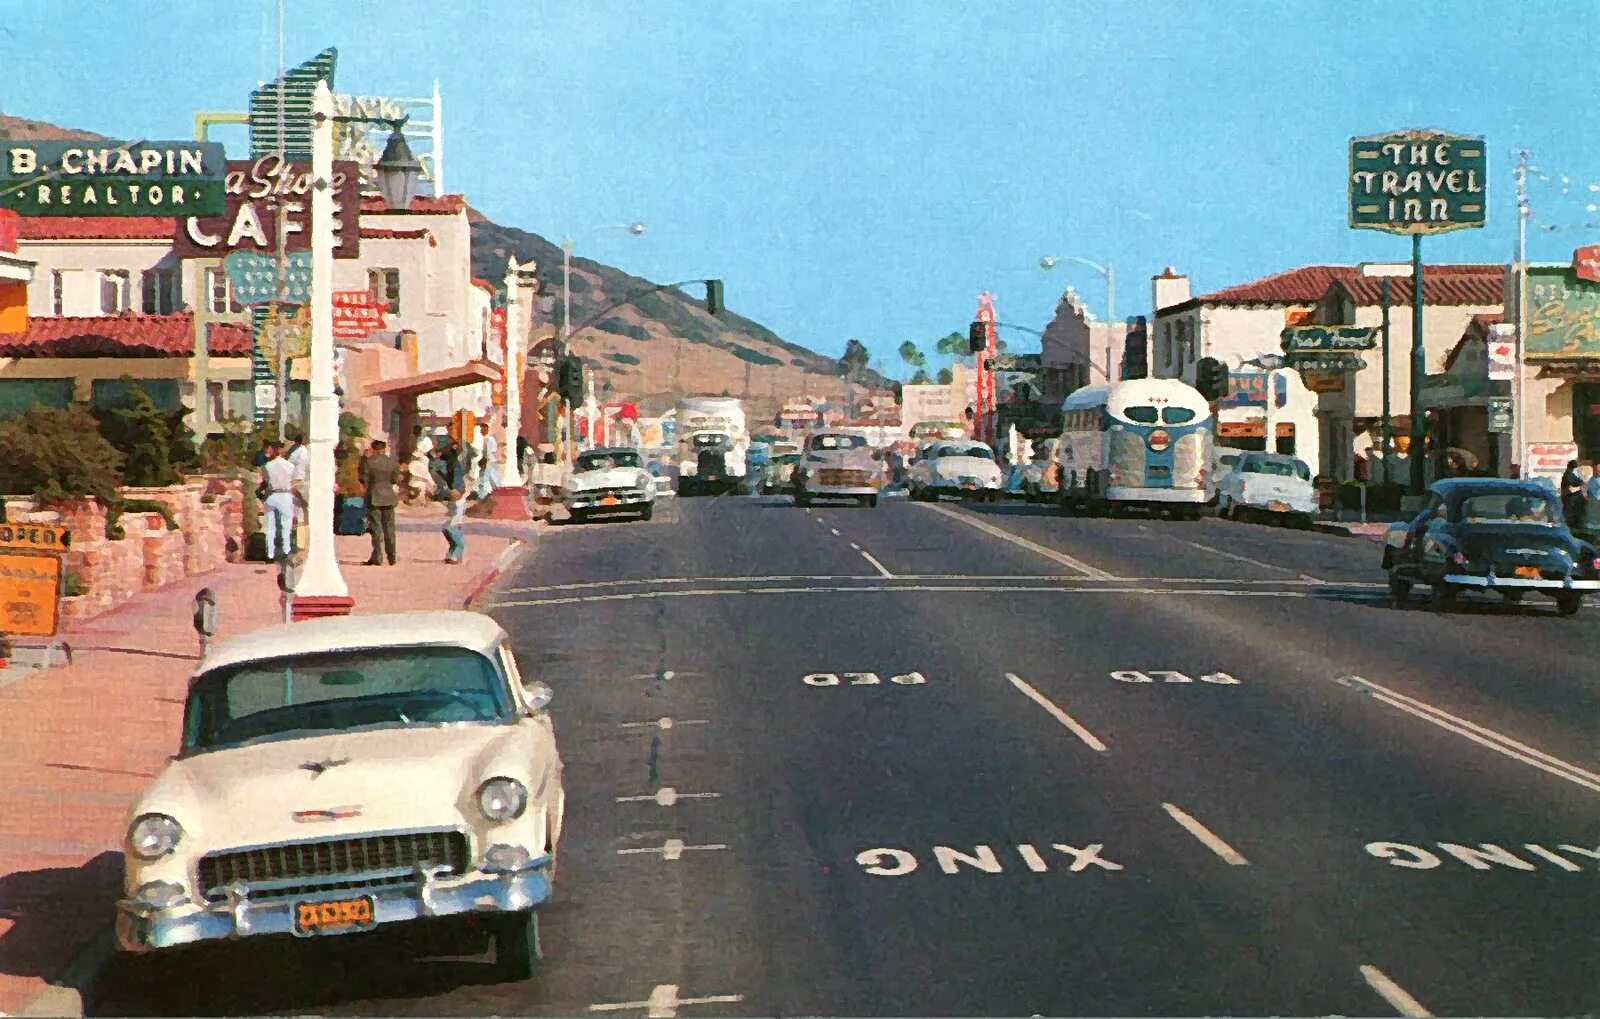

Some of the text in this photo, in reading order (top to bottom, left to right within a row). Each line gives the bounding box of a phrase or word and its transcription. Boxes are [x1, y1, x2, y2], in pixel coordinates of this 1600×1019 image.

[62, 149, 203, 174] CHAPIN
[1382, 143, 1451, 165] THE
[249, 151, 347, 199] Shoe
[1353, 169, 1482, 196] TRAVEL
[38, 184, 185, 205] REALTOR
[855, 843, 1125, 876] XING
